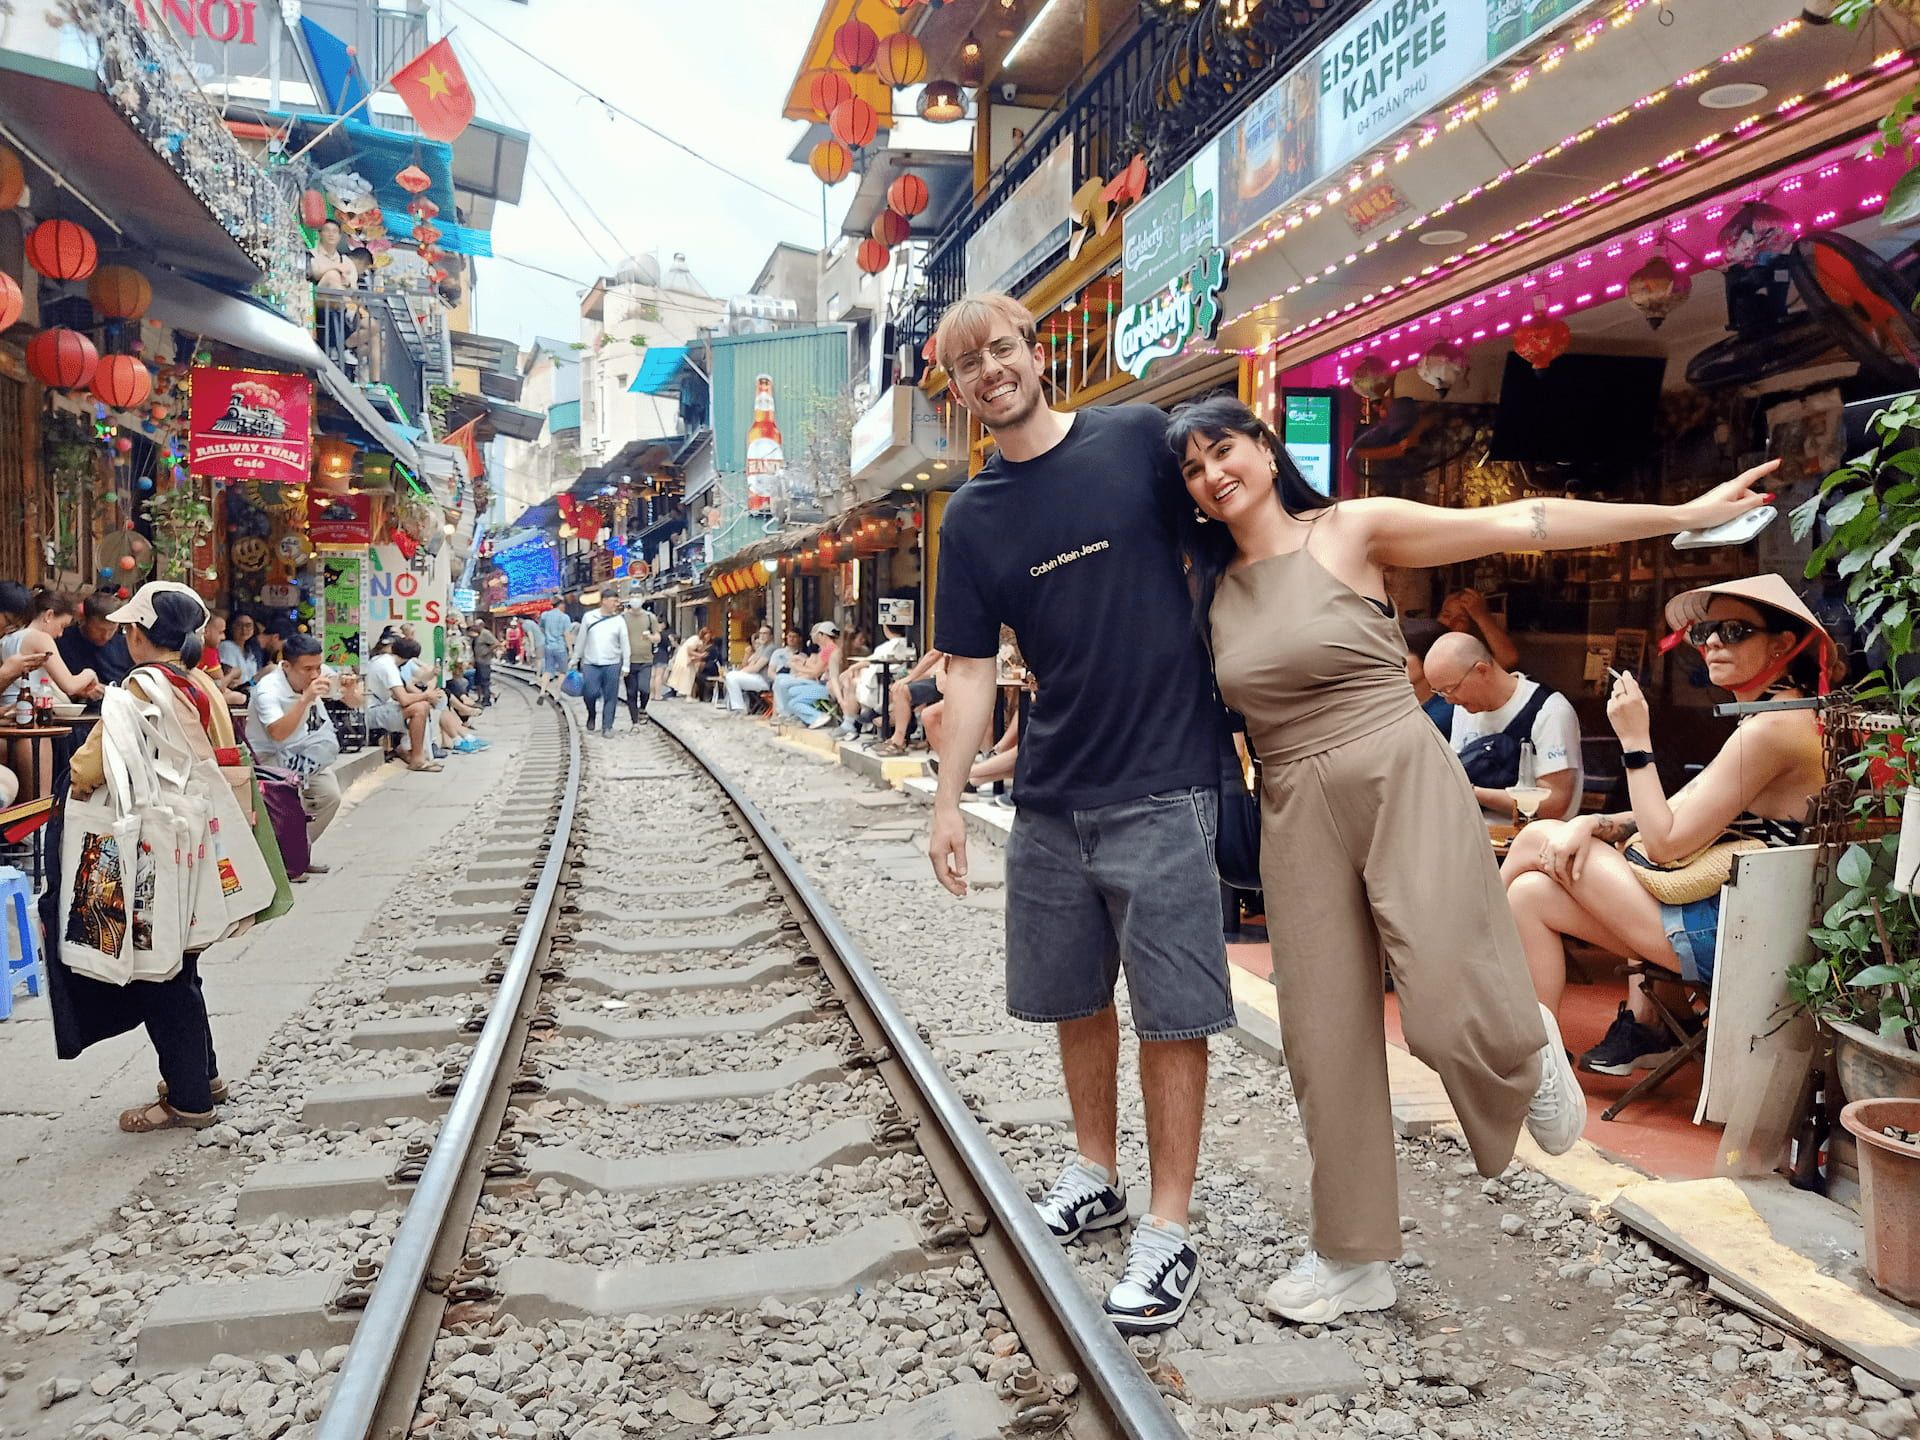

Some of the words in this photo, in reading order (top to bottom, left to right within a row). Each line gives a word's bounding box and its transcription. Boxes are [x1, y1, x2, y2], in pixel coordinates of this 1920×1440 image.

[1320, 0, 1439, 97] EISENBA
[1343, 12, 1446, 120] KAFFEE
[1126, 218, 1163, 272] Carlsberg
[1115, 277, 1194, 380] Carlsberg
[195, 443, 259, 457] RAILWAY
[262, 444, 299, 462] TUAN
[369, 572, 418, 598] NO
[1030, 559, 1058, 577] Calvin
[1057, 550, 1080, 566] Klein
[1080, 540, 1110, 556] Jeans
